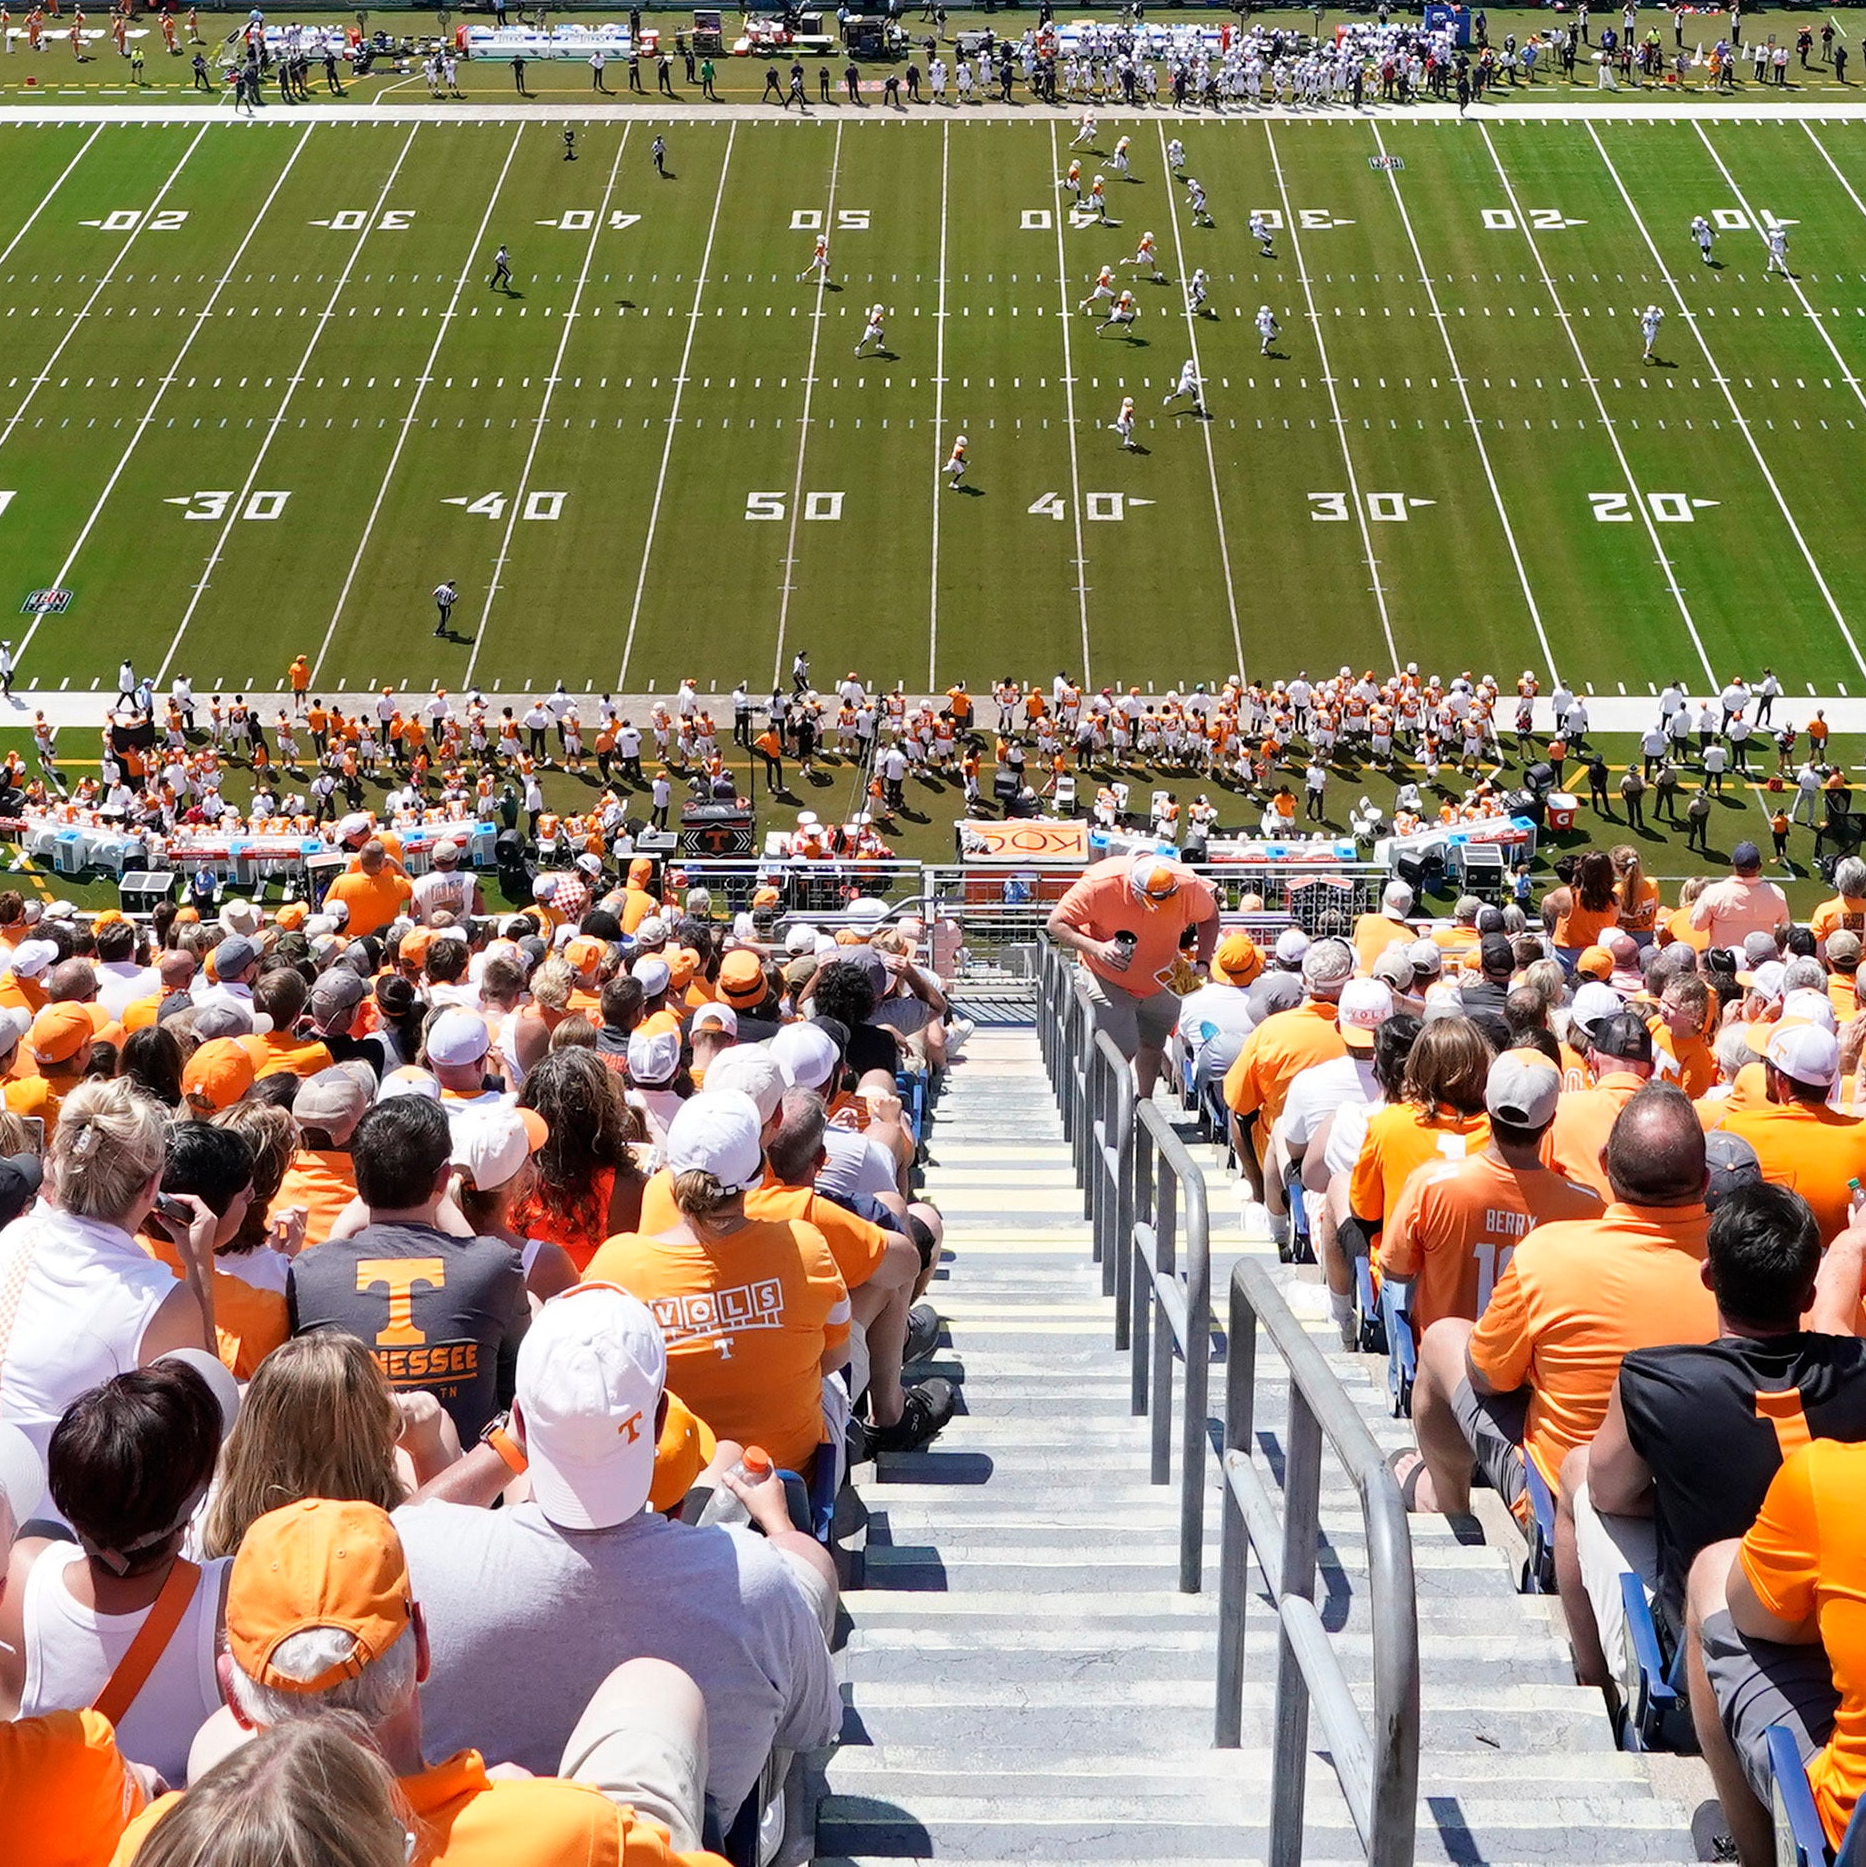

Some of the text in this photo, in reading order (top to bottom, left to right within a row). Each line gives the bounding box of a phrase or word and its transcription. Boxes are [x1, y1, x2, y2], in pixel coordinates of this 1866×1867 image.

[182, 490, 293, 520] 30
[464, 490, 568, 521] 40
[744, 491, 843, 522] 50
[1026, 491, 1124, 522] 40
[1306, 491, 1408, 522] 30
[1588, 491, 1697, 523] 20
[1557, 813, 1569, 825] G
[705, 831, 730, 851] T
[1485, 1208, 1539, 1237] BERRY
[355, 1257, 446, 1347] T
[653, 1285, 775, 1325] VOLS
[369, 1344, 479, 1377] NESSEE
[714, 1337, 734, 1360] T
[618, 1410, 642, 1444] T
